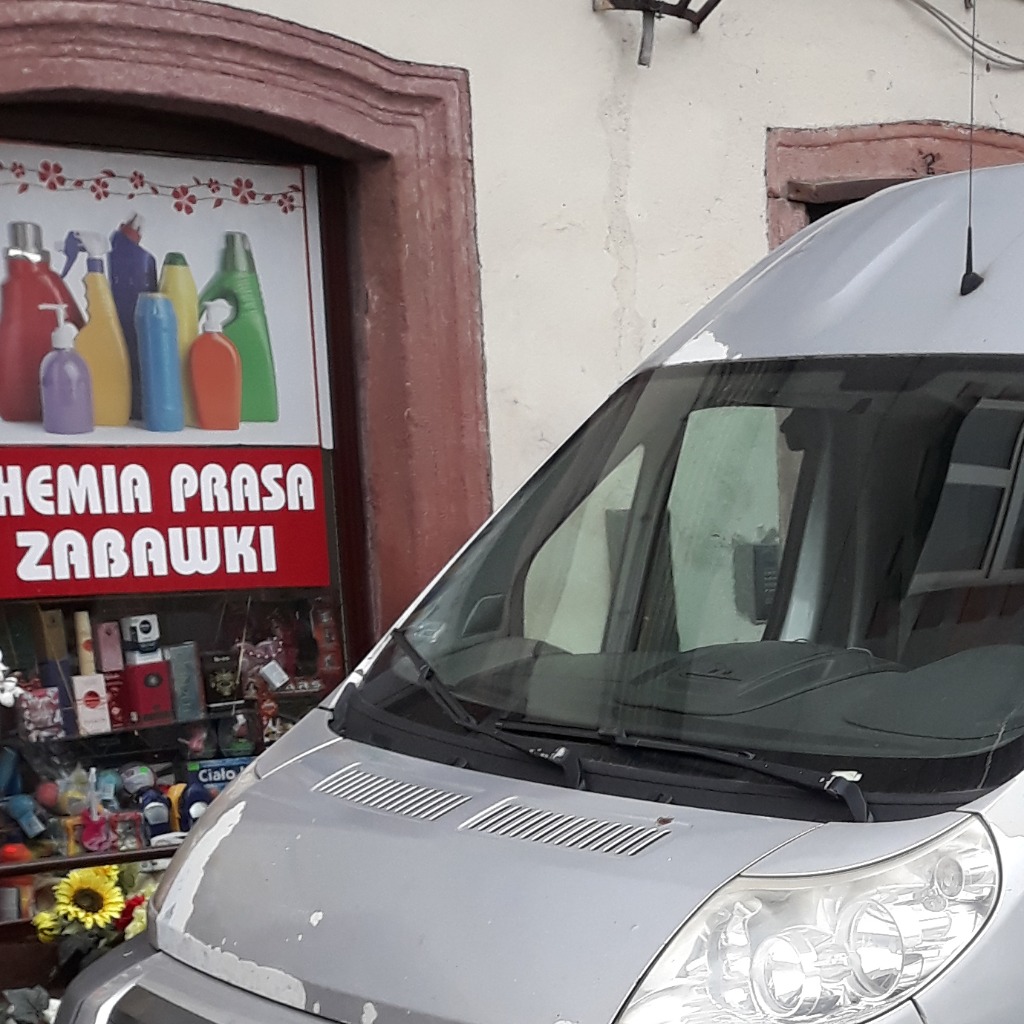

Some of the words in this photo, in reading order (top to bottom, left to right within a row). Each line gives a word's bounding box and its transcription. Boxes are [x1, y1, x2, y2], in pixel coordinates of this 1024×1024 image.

[0, 463, 152, 517] HEMIA
[170, 463, 315, 513] PRASA
[15, 525, 277, 582] ZABAWKI
